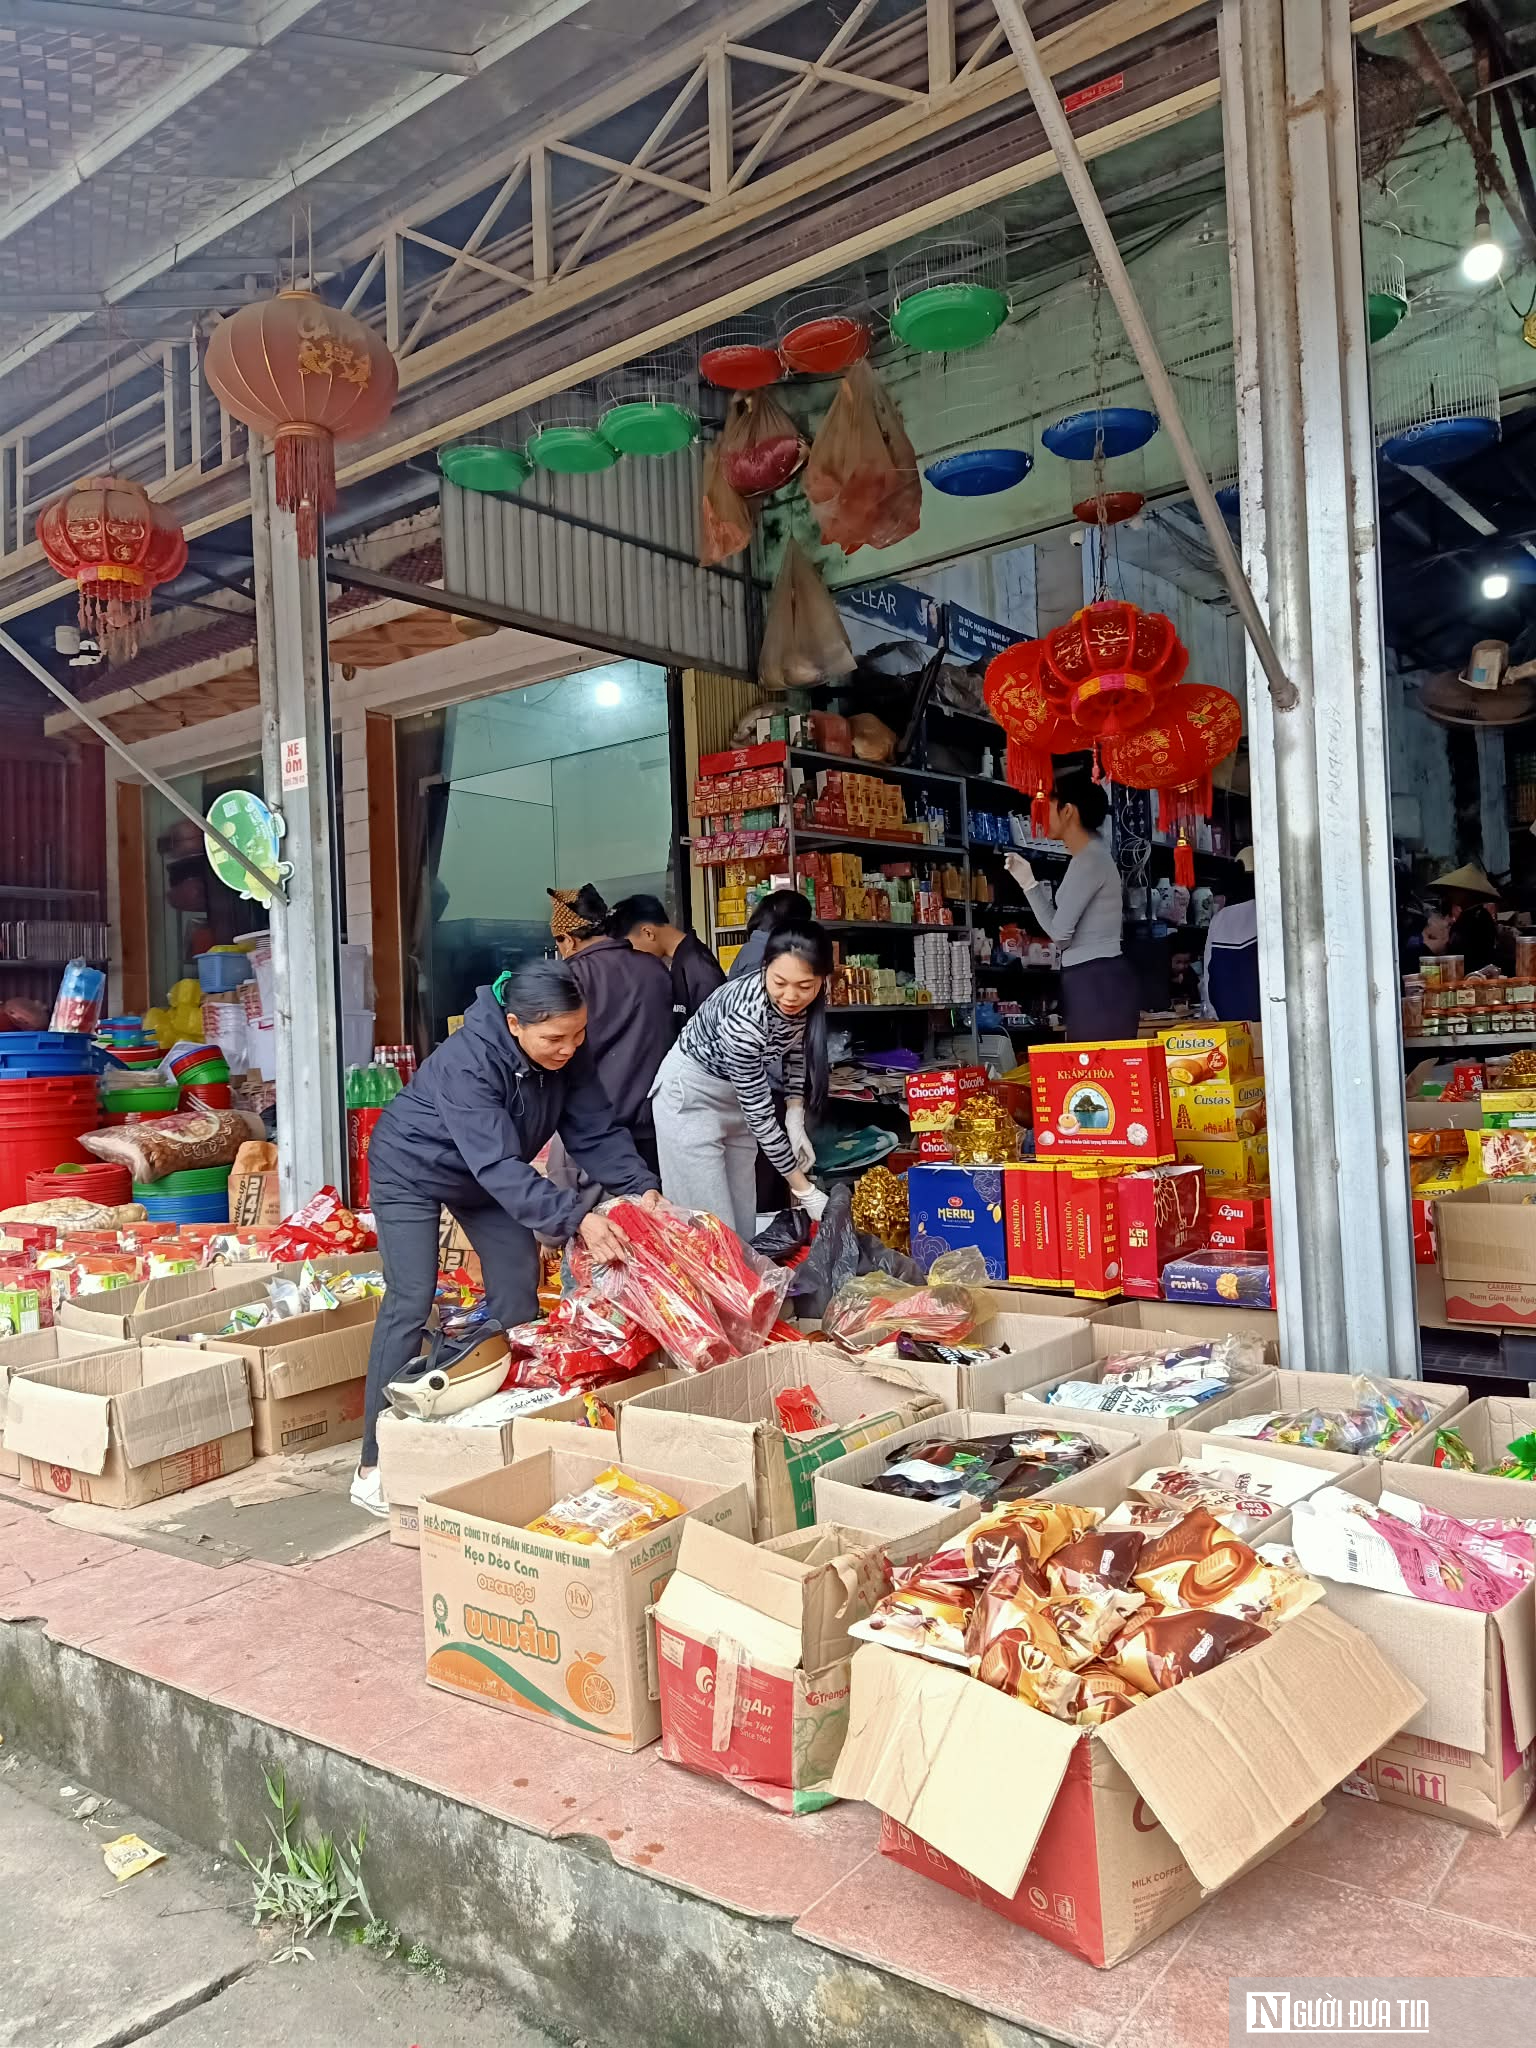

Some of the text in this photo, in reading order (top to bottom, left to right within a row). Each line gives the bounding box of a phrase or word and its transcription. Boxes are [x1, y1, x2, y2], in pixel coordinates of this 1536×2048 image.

[1166, 1036, 1215, 1050] Custas
[1092, 1066, 1114, 1078] HÒA
[908, 1085, 956, 1098] ChocoPie
[1194, 1094, 1230, 1104] Custas
[1238, 1087, 1264, 1102] Custas
[938, 1208, 974, 1223] MERRY
[1035, 1220, 1044, 1250] KHÁNH
[1076, 1207, 1086, 1260] KHÁNH HÒA
[1129, 1228, 1148, 1236] KEN
[1488, 1283, 1522, 1291] CARAMELS
[1242, 1501, 1264, 1510] Day
[424, 1514, 461, 1537] HEADWAY
[464, 1526, 590, 1569] CÔNG TY CỔ PHẦN HEADWAY VIỆT NAM
[630, 1536, 672, 1568] HEADWAY
[464, 1545, 485, 1565] Kẹo
[488, 1551, 510, 1570] Dẻo
[514, 1560, 540, 1579] Cam
[463, 1604, 561, 1664] ขนมส้ม
[740, 1727, 771, 1744] Since 1964
[1132, 1864, 1184, 1888] MILK COFFEE
